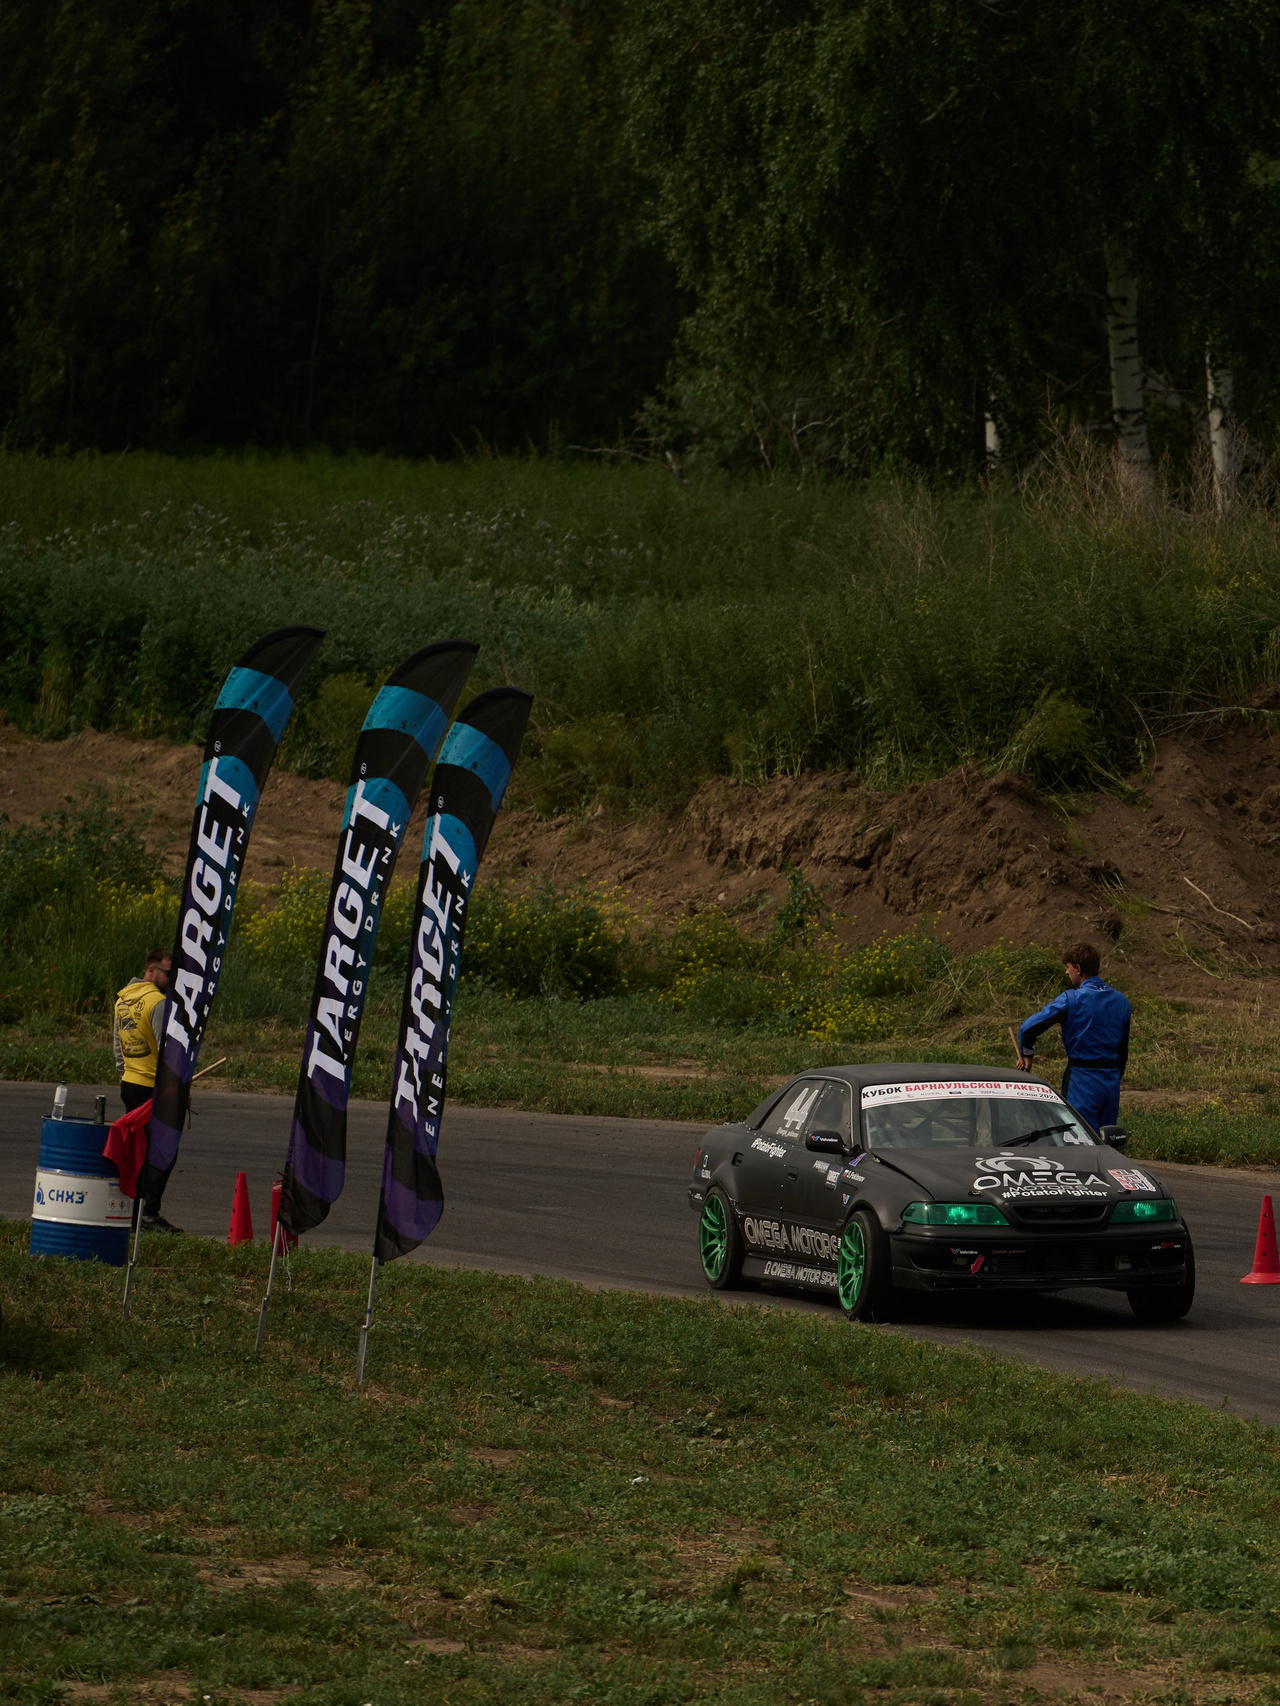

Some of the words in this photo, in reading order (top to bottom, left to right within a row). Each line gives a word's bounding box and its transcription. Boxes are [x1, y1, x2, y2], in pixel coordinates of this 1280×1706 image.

[224, 801, 250, 911] DRINK
[364, 821, 400, 932] DRINK
[166, 756, 242, 1053] TARGET
[449, 869, 471, 980] DRINK
[307, 779, 390, 1082] TARGET
[395, 812, 460, 1123] TARGET
[784, 1087, 819, 1130] 44
[862, 1086, 902, 1099] КУБОК
[905, 1081, 1001, 1092] БАРНАУЛЬСКОЙ
[1005, 1083, 1053, 1094] РАКЕТЫ
[1038, 1092, 1059, 1100] 2025
[973, 1171, 1111, 1190] OMEGA
[1001, 1188, 1108, 1199] #PotatoFighter
[744, 1217, 792, 1250] OMEGA
[791, 1225, 839, 1261] MOTORS
[795, 1267, 820, 1284] MOTOR
